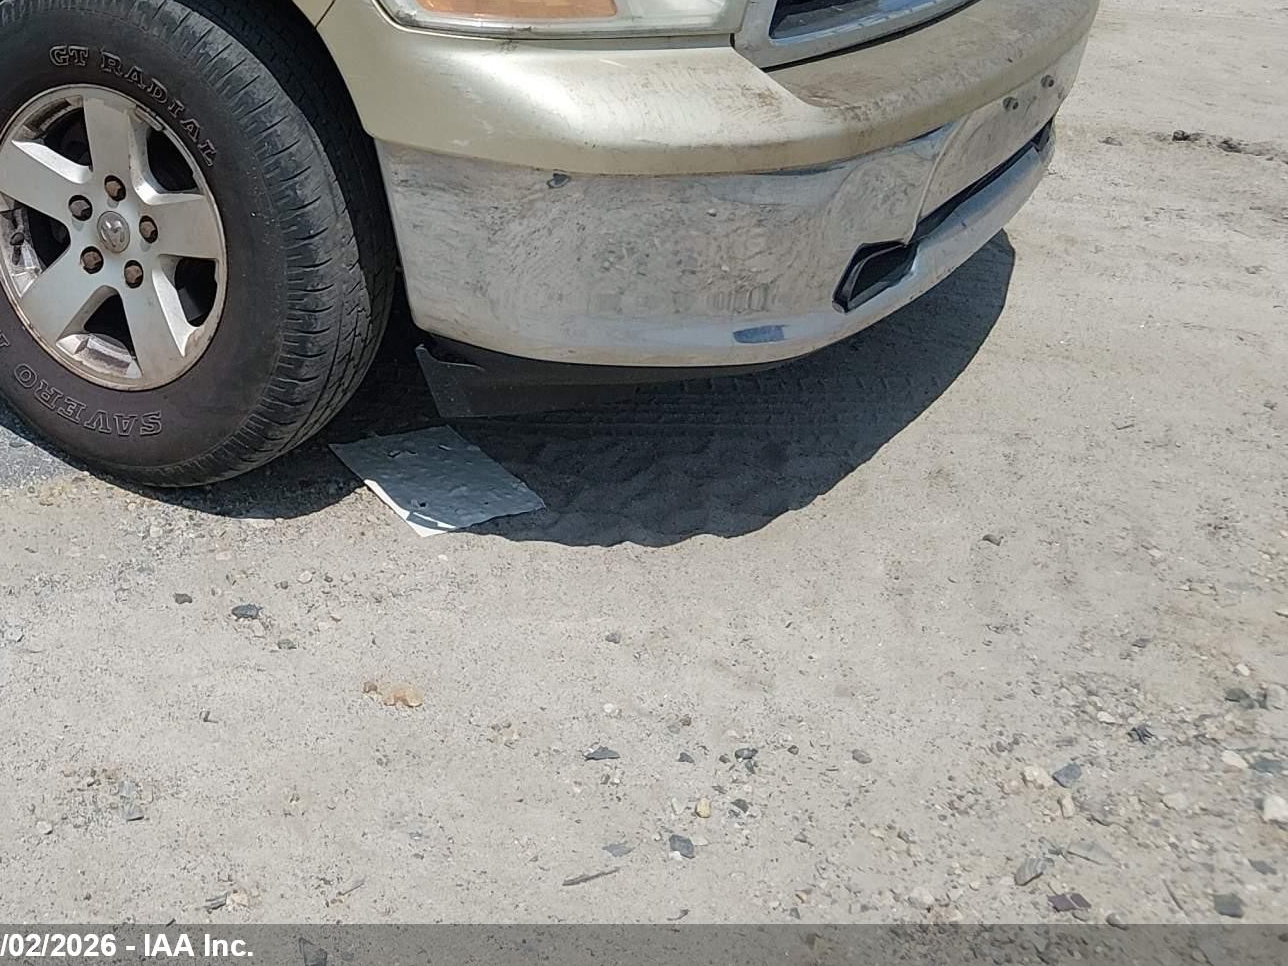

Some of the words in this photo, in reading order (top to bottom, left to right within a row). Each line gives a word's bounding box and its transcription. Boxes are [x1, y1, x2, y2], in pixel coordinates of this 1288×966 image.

[49, 44, 89, 68] GT
[99, 46, 218, 167] RADIAL
[13, 363, 162, 437] SAVERO
